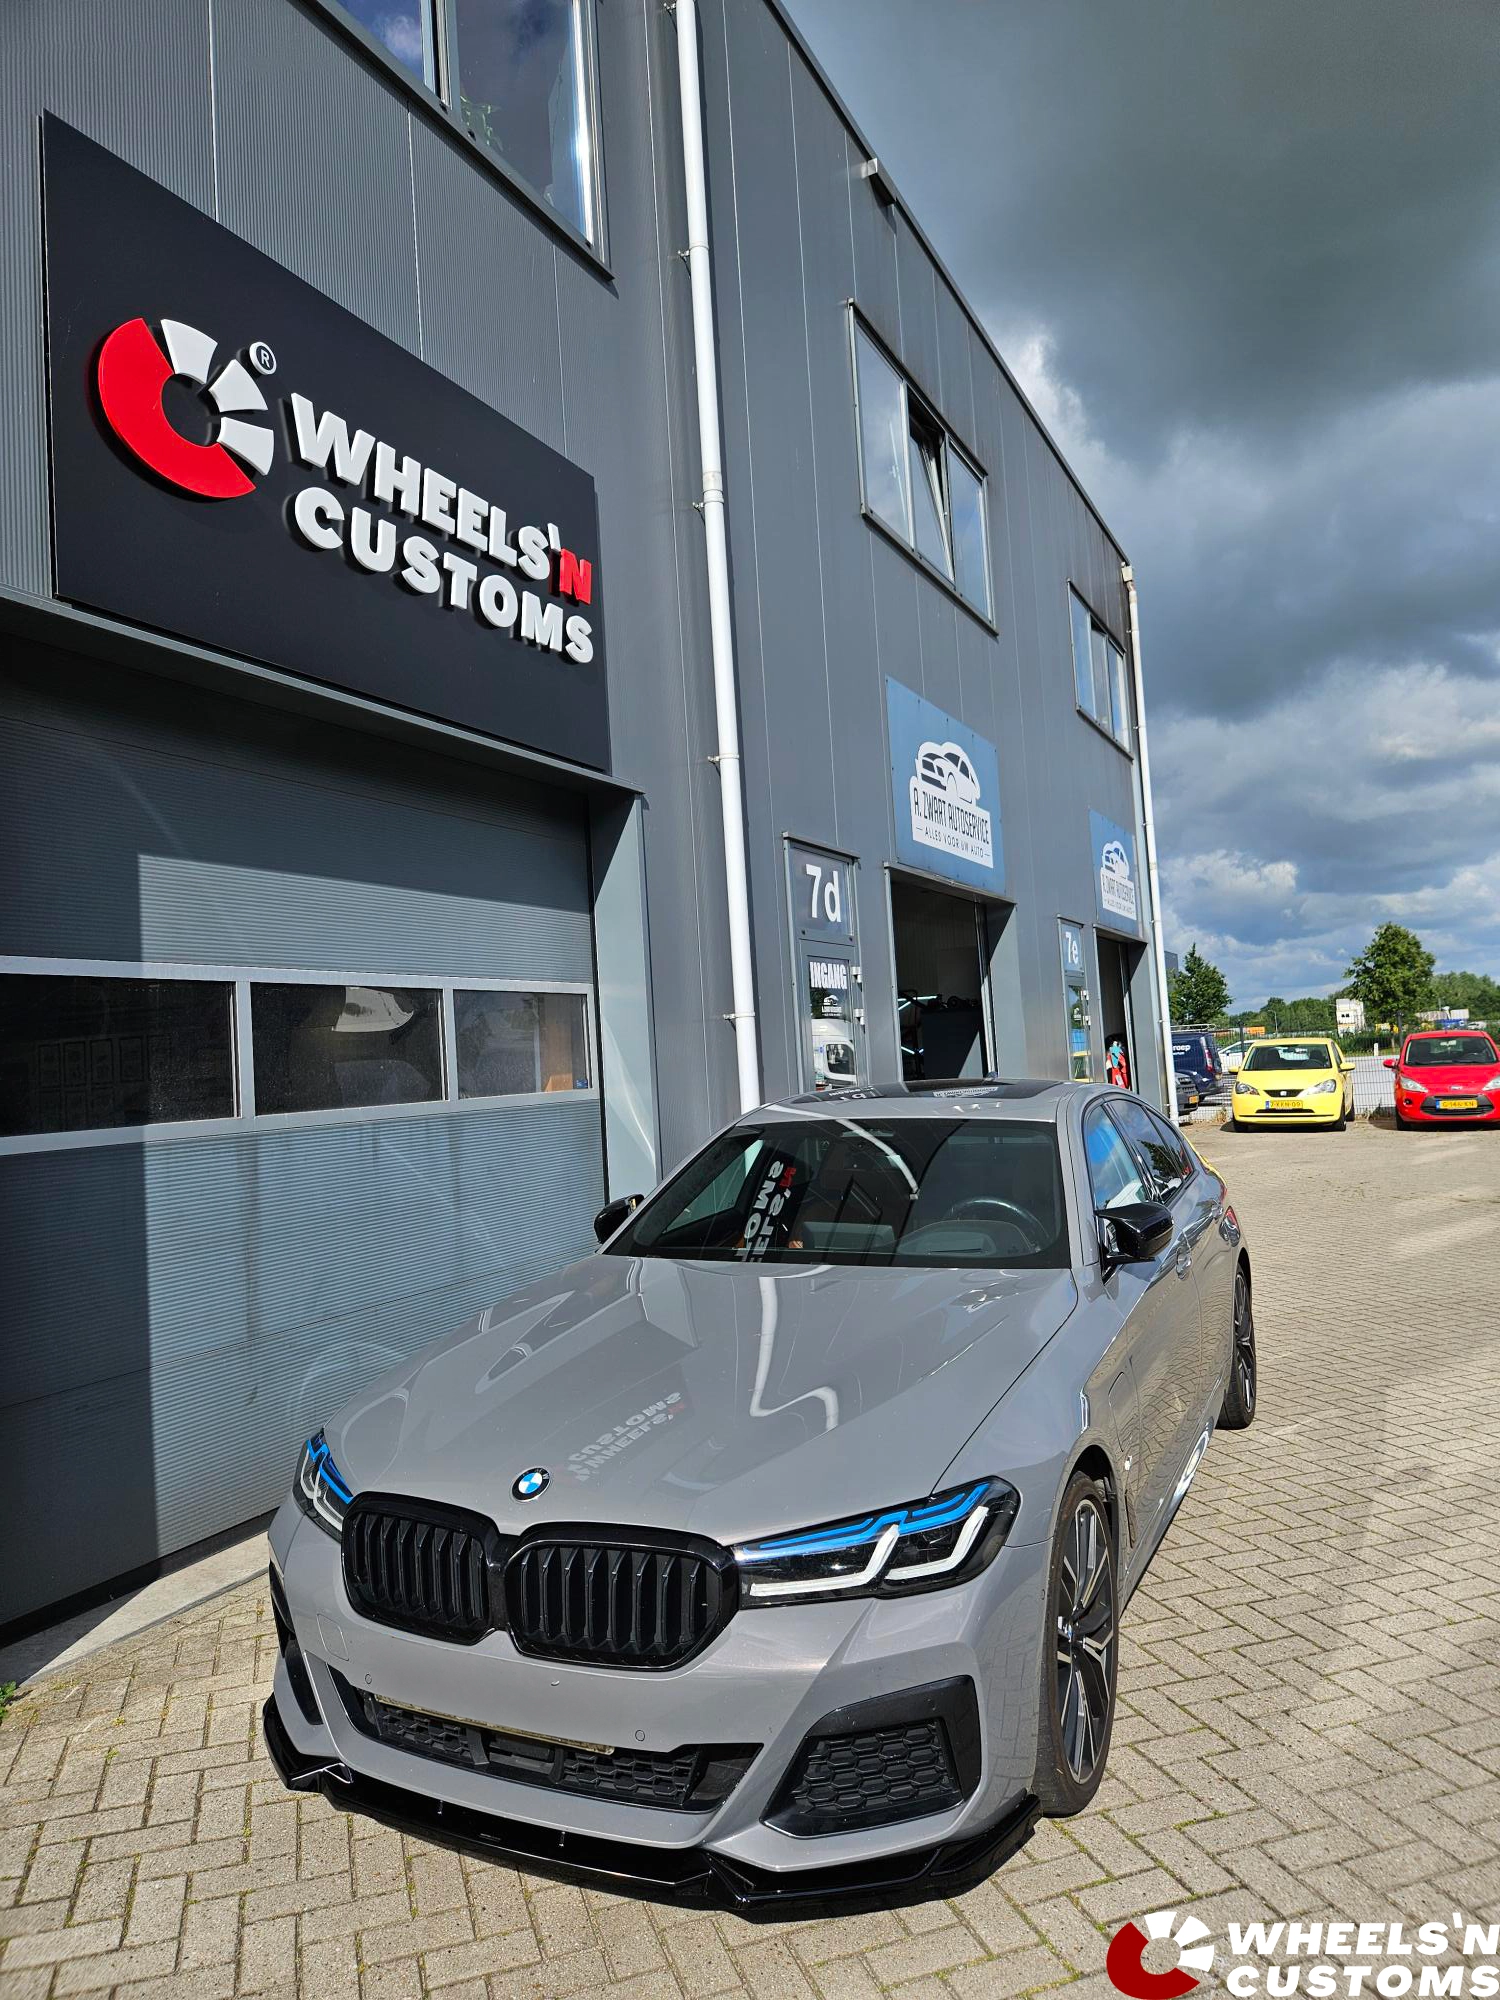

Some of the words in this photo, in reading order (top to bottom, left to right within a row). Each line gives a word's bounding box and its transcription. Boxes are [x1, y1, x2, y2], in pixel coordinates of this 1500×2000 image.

[291, 393, 593, 605] WHEELS'N
[294, 486, 594, 664] CUSTOMS
[922, 791, 947, 827] ZWART
[948, 803, 990, 845] AUTOSERVICE
[925, 826, 941, 842] ALLES
[943, 832, 960, 849] VOOR
[970, 845, 984, 858] AUTO
[805, 863, 842, 922] 7d
[1065, 931, 1079, 964] 7e
[809, 961, 848, 990] INGANG
[1172, 1044, 1191, 1052] roep
